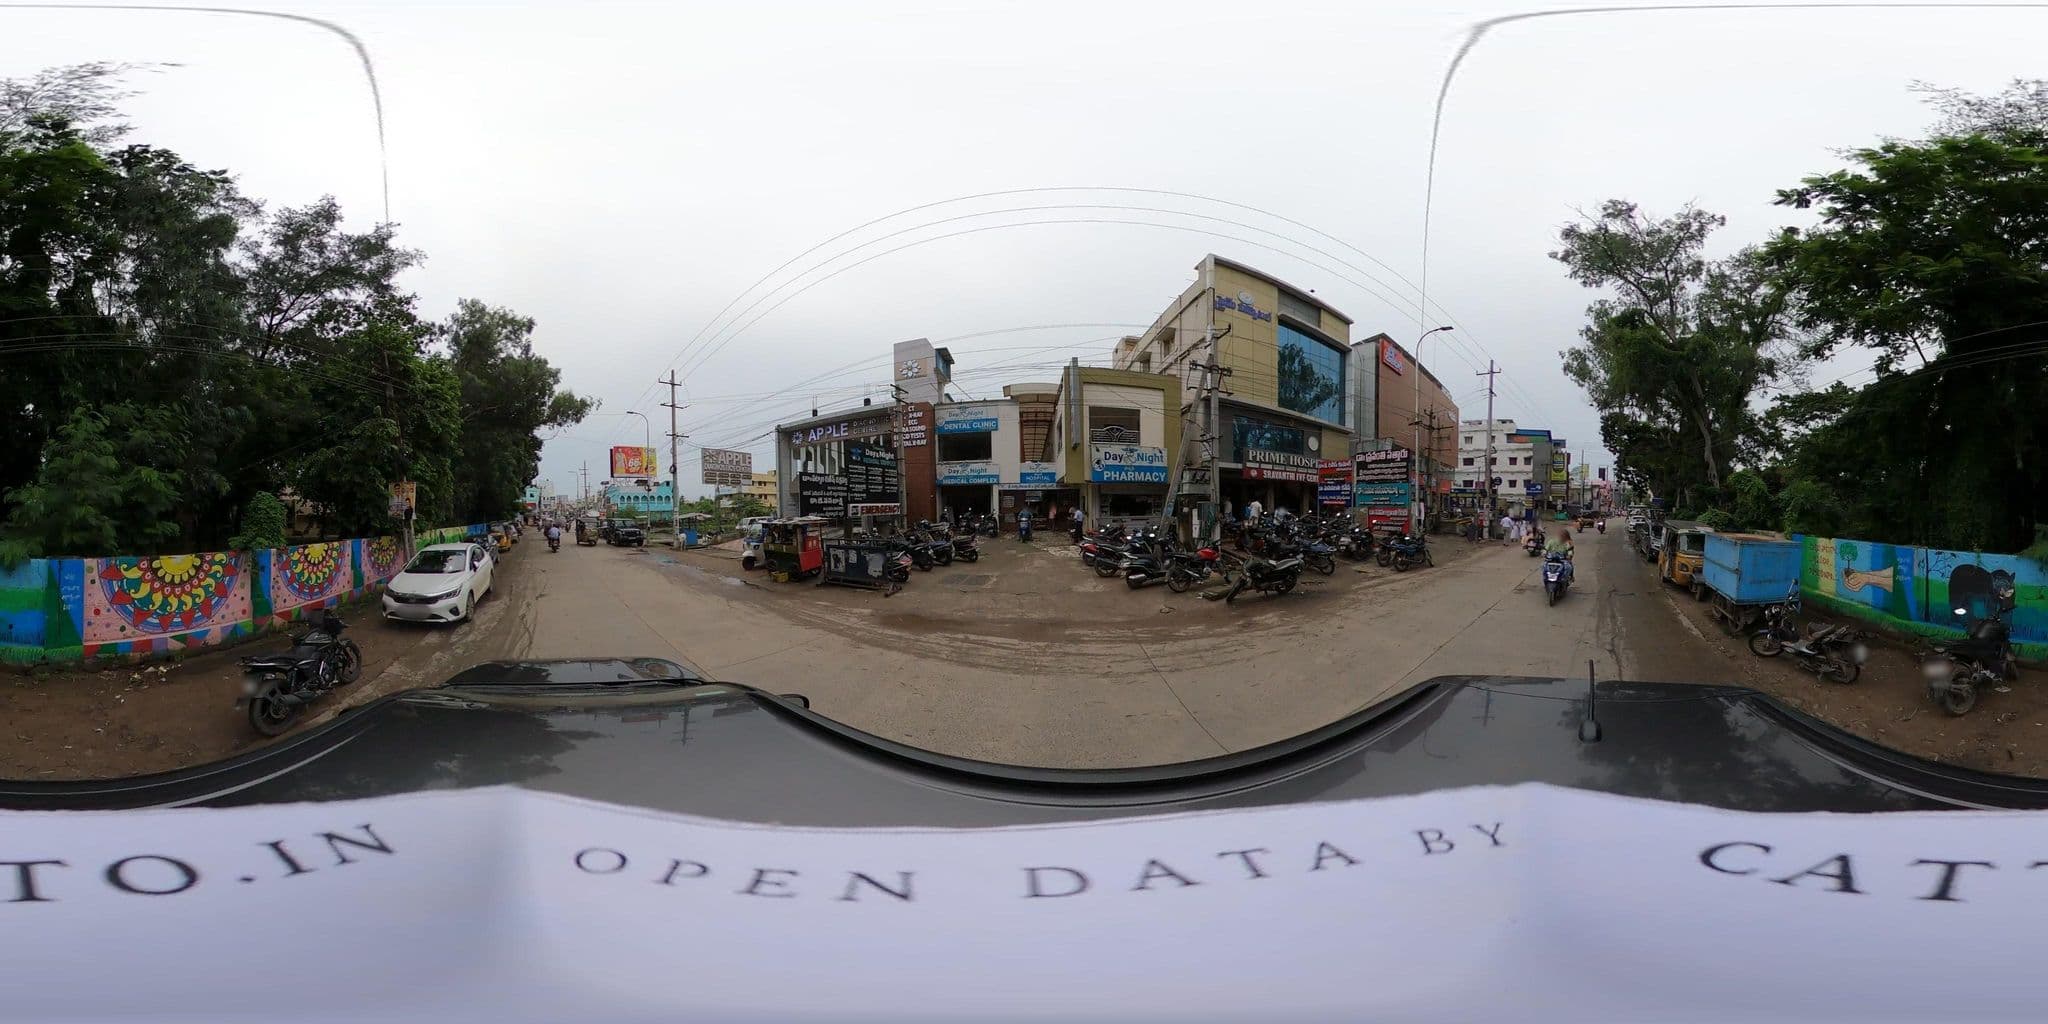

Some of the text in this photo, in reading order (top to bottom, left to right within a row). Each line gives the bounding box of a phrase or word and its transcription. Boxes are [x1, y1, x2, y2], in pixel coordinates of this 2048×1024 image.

[972, 420, 997, 429] CLINIC
[808, 422, 849, 442] APPLE
[719, 450, 752, 466] APPLE
[1104, 450, 1164, 463] Day Night
[1248, 449, 1288, 465] PRIME
[1289, 455, 1318, 468] HOSPI
[969, 476, 998, 484] COMPLEX
[1103, 471, 1166, 482] PHARMACY
[860, 504, 900, 515] EMERGENCY
[574, 821, 1505, 903] OPEN DATA BY
